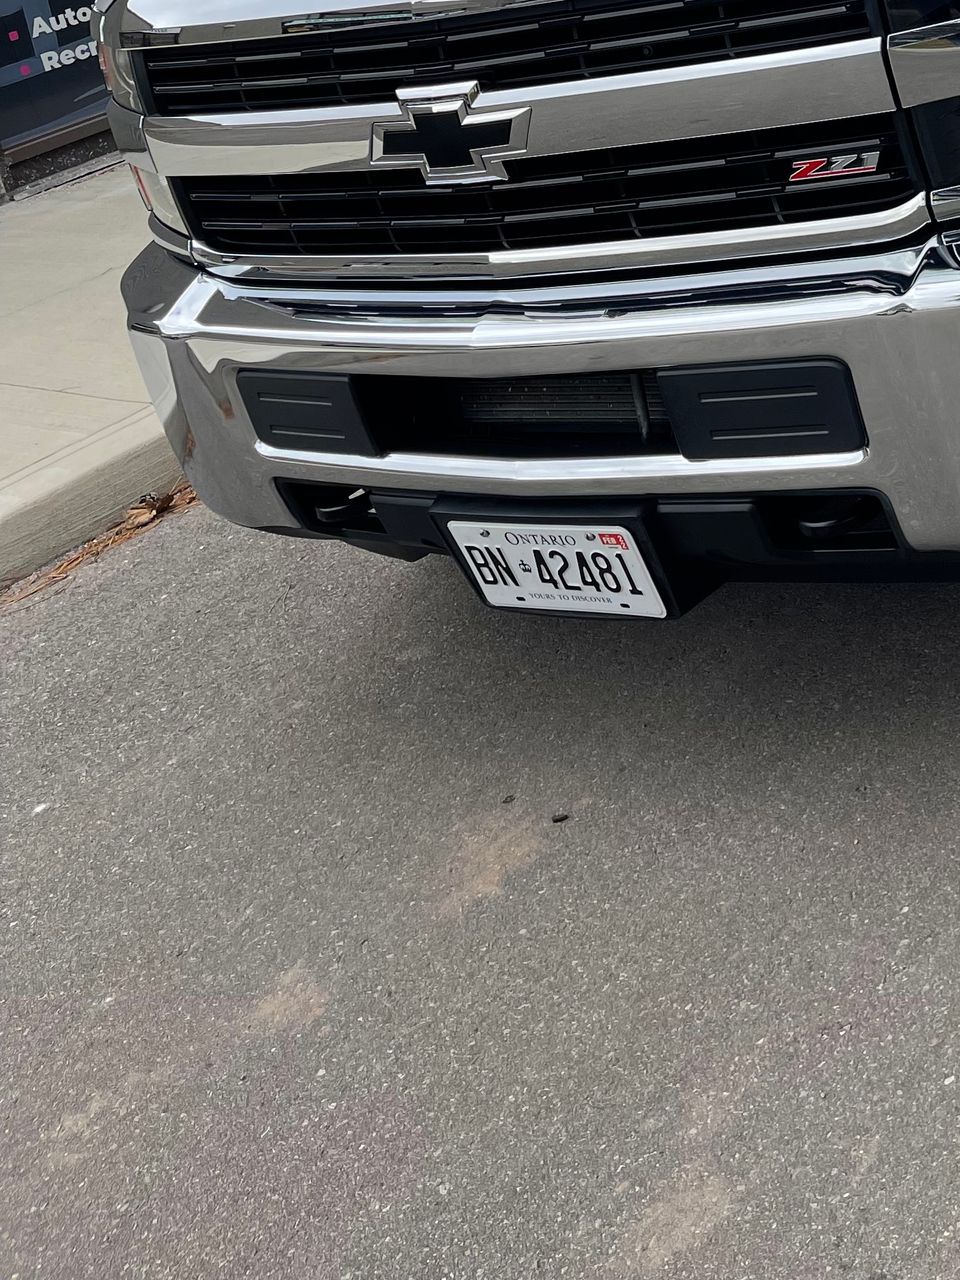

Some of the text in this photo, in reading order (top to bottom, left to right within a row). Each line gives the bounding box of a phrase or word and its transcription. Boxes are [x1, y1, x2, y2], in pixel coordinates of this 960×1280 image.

[789, 151, 880, 181] Z71
[504, 531, 577, 547] ONTARIO
[465, 545, 643, 595] BN 42481
[528, 592, 556, 600] YOURS
[571, 595, 613, 603] DISCOVER
